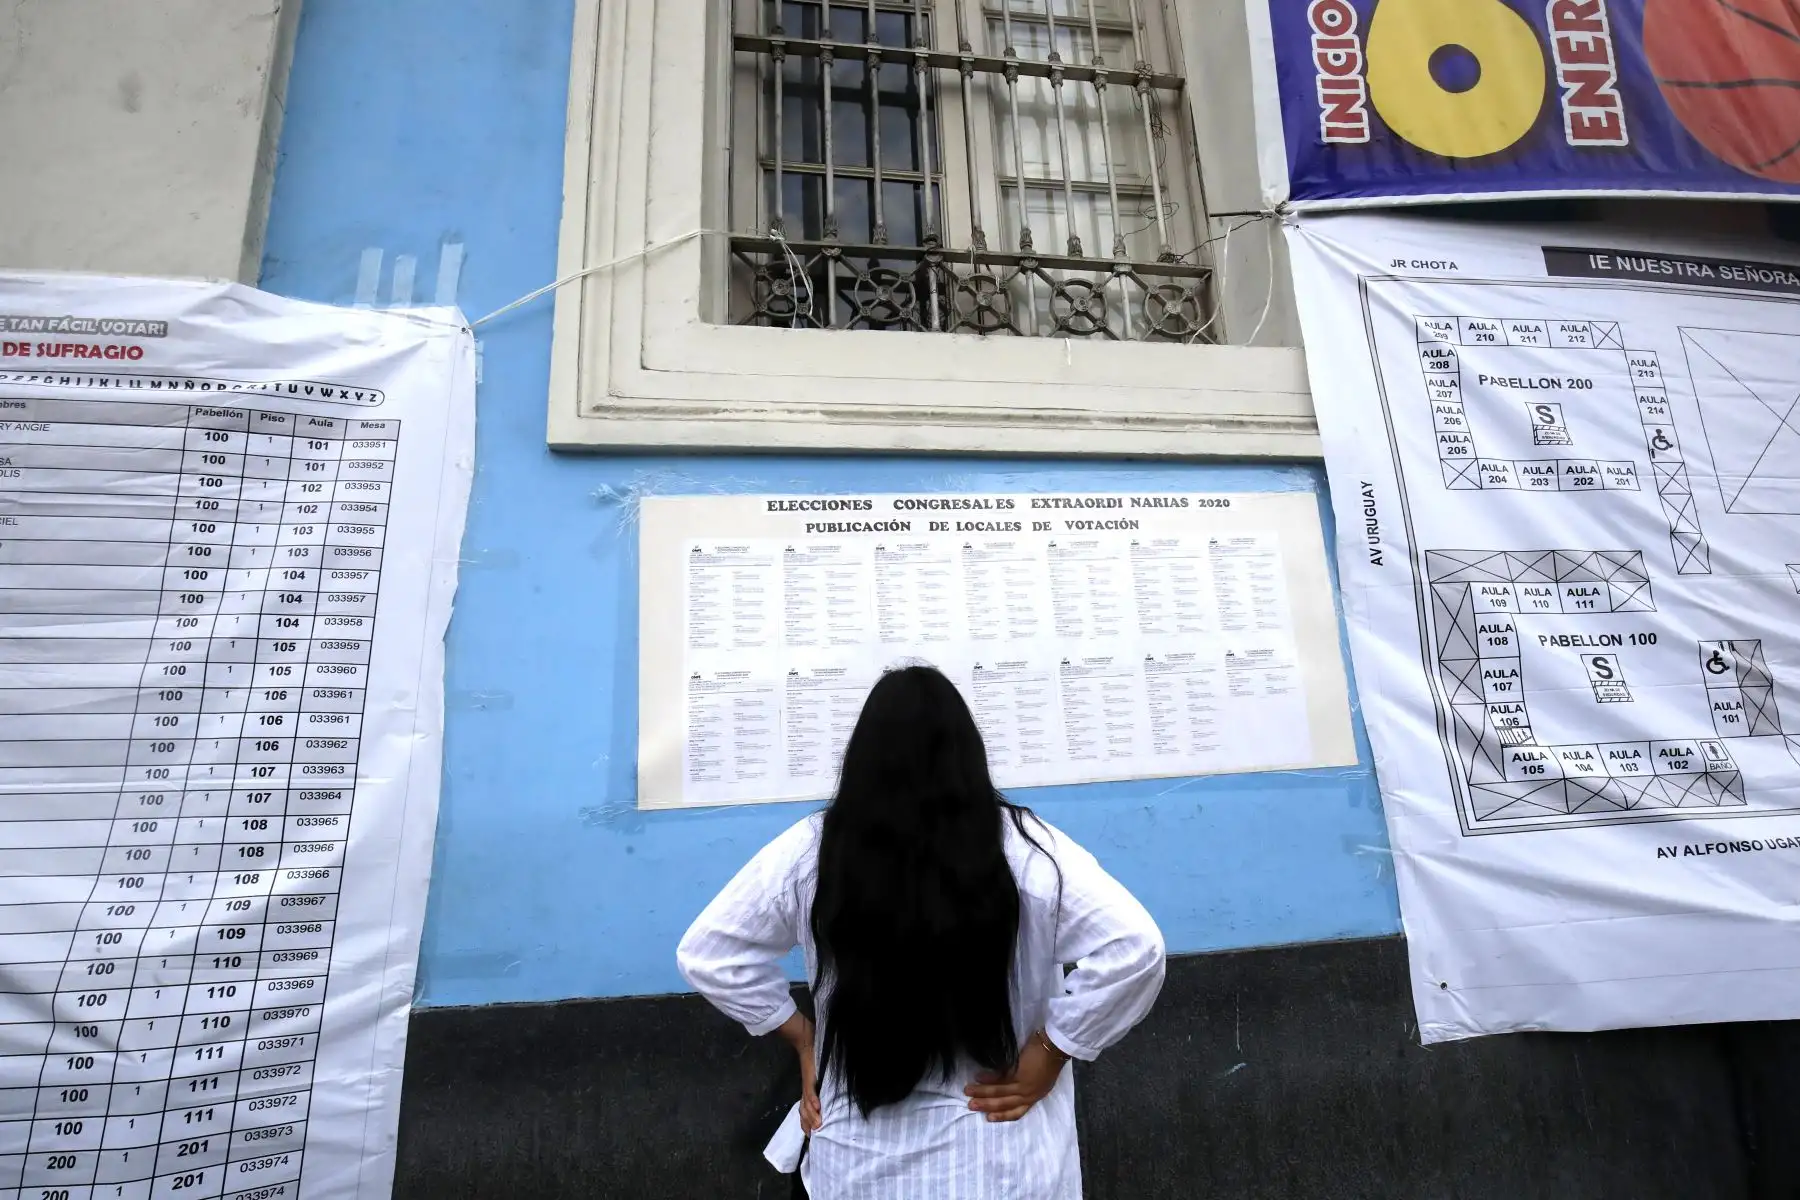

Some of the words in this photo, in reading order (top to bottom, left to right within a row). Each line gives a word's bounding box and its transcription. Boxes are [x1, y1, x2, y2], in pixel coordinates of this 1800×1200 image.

[1307, 0, 1371, 144] INICIO
[1390, 259, 1407, 268] JR
[1411, 260, 1458, 270] CHOTA
[1589, 254, 1612, 269] IE
[1616, 256, 1715, 278] NUESTRA
[1720, 265, 1800, 286] SEÑORA
[10, 318, 44, 331] TAN
[47, 316, 98, 333] FÁCIL
[101, 321, 165, 335] VOTAR!
[1468, 322, 1498, 331] AULA
[1512, 325, 1542, 333] AULA
[1560, 325, 1589, 333] AULA
[1476, 333, 1495, 342] 210
[1520, 335, 1537, 343] 211
[1568, 335, 1586, 343] 212
[2, 341, 32, 357] DE
[36, 342, 144, 360] SUFRAGIO
[1422, 349, 1455, 358] AULA
[1429, 360, 1450, 369] 208
[1630, 359, 1658, 368] AULA
[1637, 369, 1655, 378] 213
[1428, 379, 1458, 388] AULA
[1478, 374, 1562, 389] PABELLON
[1566, 378, 1593, 389] 200
[275, 383, 282, 392] T
[288, 384, 298, 393] U
[304, 385, 314, 395] V
[320, 387, 333, 398] W
[339, 390, 349, 399] X
[355, 392, 364, 401] Y
[369, 393, 377, 402] Z
[1436, 390, 1453, 398] 207
[1639, 395, 1667, 404] AULA
[1436, 406, 1464, 415] AULA
[1535, 405, 1555, 425] S
[1647, 406, 1664, 414] 214
[195, 408, 243, 419] Pabellón
[260, 413, 285, 423] Piso
[308, 418, 333, 428] Aula
[1443, 417, 1462, 425] 206
[14, 423, 50, 432] ANGIE
[204, 431, 229, 442] 100
[307, 440, 329, 450] 101
[1440, 435, 1471, 443] AULA
[1447, 446, 1468, 455] 205
[1480, 463, 1509, 472] AULA
[1523, 466, 1554, 475] AULA
[1565, 466, 1598, 475] AULA
[1607, 467, 1634, 476] AULA
[1488, 475, 1507, 483] 204
[1530, 477, 1549, 486] 203
[1573, 477, 1594, 486] 202
[1615, 477, 1631, 486] 201
[198, 477, 223, 488] 100
[301, 483, 322, 492] 102
[344, 482, 381, 491] 033953
[767, 500, 873, 512] ELECCIONES
[893, 499, 1015, 510] CONGRESALES
[1198, 499, 1230, 508] 2020
[1361, 479, 1381, 545] URUGUAY
[192, 523, 216, 533] 100
[292, 526, 313, 535] 103
[337, 525, 375, 535] 033955
[805, 519, 911, 533] PUBLICACIÓN
[929, 521, 950, 531] DE
[956, 521, 1022, 532] LOCALES
[1032, 521, 1052, 531] DE
[1064, 517, 1139, 530] VOTACIÓN
[1369, 548, 1383, 566] AV
[184, 570, 208, 580] 100
[283, 570, 306, 580] 104
[331, 571, 369, 580] 033957
[1481, 586, 1510, 596] AULA
[1524, 588, 1552, 597] AULA
[1567, 587, 1600, 597] AULA
[1490, 599, 1507, 607] 109
[1532, 600, 1549, 608] 110
[1575, 599, 1594, 609] 111
[176, 617, 198, 628] 100
[276, 617, 299, 628] 104
[324, 617, 363, 627] 033958
[1479, 624, 1514, 634] AULA
[1487, 636, 1509, 646] 108
[1538, 634, 1623, 647] PABELLON
[1629, 632, 1657, 645] 100
[163, 665, 186, 676] 100
[269, 666, 292, 676] 105
[316, 665, 357, 675] 033960
[1592, 656, 1614, 680] S
[1484, 669, 1519, 679] AULA
[1492, 682, 1512, 691] 107
[1490, 704, 1524, 714] AULA
[1714, 701, 1743, 711] AULA
[154, 716, 179, 727] 100
[259, 715, 283, 725] 106
[309, 714, 350, 724] 033961
[1499, 716, 1519, 726] 106
[1722, 714, 1740, 723] 101
[1512, 752, 1548, 763] AULA
[1562, 750, 1594, 760] AULA
[1609, 749, 1642, 760] AULA
[1659, 747, 1695, 758] AULA
[1521, 764, 1545, 775] 105
[1575, 764, 1594, 772] 104
[1620, 762, 1639, 772] 103
[1667, 760, 1689, 770] 102
[1709, 761, 1733, 771] BAÑO
[145, 768, 170, 780] 100
[251, 766, 276, 778] 107
[302, 765, 345, 775] 033963
[132, 821, 158, 833] 100
[242, 819, 268, 830] 108
[296, 817, 339, 827] 033965
[1657, 846, 1677, 859] AV
[1683, 840, 1763, 857] ALFONSO
[118, 877, 144, 888] 100
[234, 873, 260, 885] 108
[287, 869, 330, 879] 033966
[96, 932, 122, 945] 100
[217, 928, 246, 940] 109
[277, 923, 322, 934] 033968
[78, 993, 107, 1007] 100
[207, 985, 236, 999] 110
[268, 979, 314, 991] 033969
[67, 1056, 94, 1070] 100
[195, 1046, 224, 1060] 111
[258, 1037, 304, 1051] 033971
[55, 1121, 83, 1135] 100
[184, 1108, 213, 1124] 111
[249, 1095, 297, 1111] 033972
[46, 1155, 76, 1170] 200
[177, 1139, 209, 1157] 201
[244, 1125, 293, 1142] 033973
